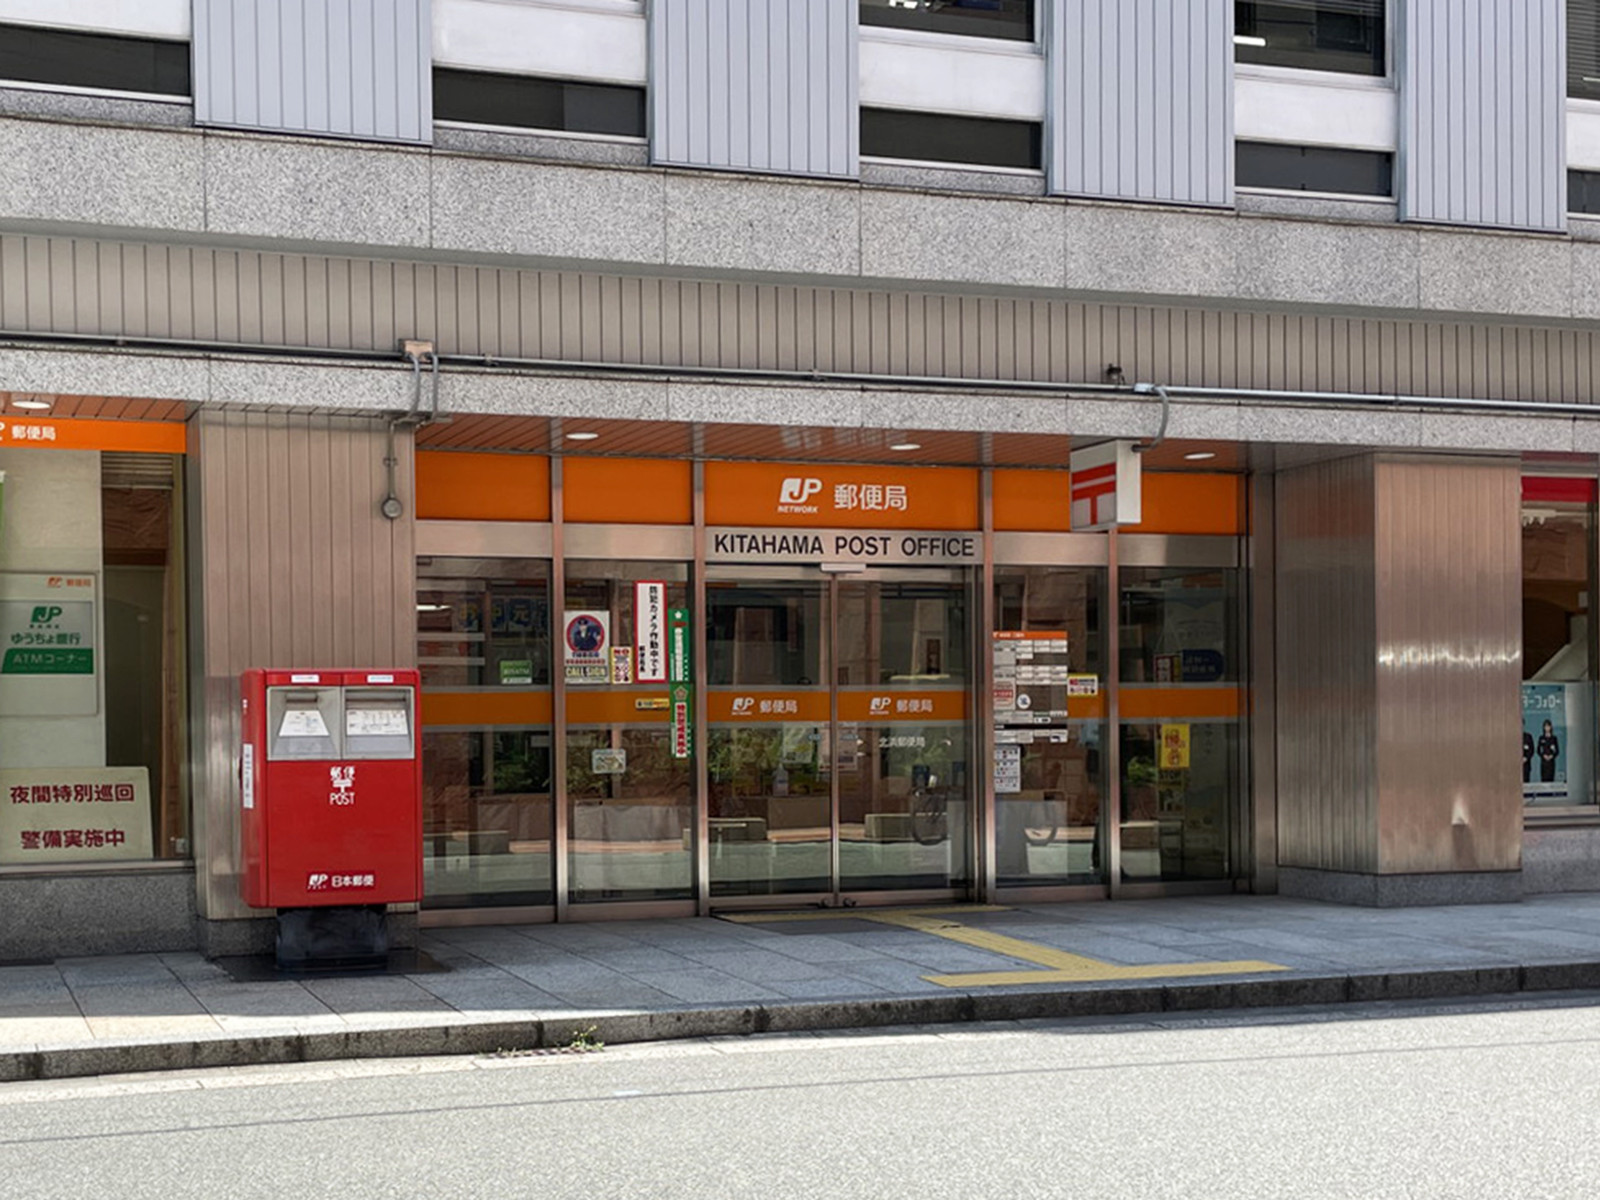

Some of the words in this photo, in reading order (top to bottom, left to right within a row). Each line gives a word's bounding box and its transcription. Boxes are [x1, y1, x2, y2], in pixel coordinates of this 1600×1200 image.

[12, 425, 56, 441] 郵便局
[779, 477, 823, 503] JP
[834, 483, 908, 512] 郵便局
[777, 504, 819, 514] NETWORK
[714, 533, 825, 555] KITAHAMA
[834, 535, 892, 556] POST
[900, 536, 975, 557] OFFICE
[30, 605, 63, 624] JP
[10, 631, 82, 645] ゆうちょ銀行
[12, 653, 88, 665] ATMコーナー
[731, 697, 755, 712] JP
[759, 699, 798, 714] 郵便局
[870, 697, 892, 711] JP
[896, 698, 934, 713] 郵便局
[329, 766, 356, 781] 郵便
[9, 784, 135, 804] 夜間特別巡回
[329, 792, 356, 806] POST
[20, 829, 126, 849] 警備実施中
[308, 873, 329, 886] JP
[331, 874, 375, 888] 日本郵便
